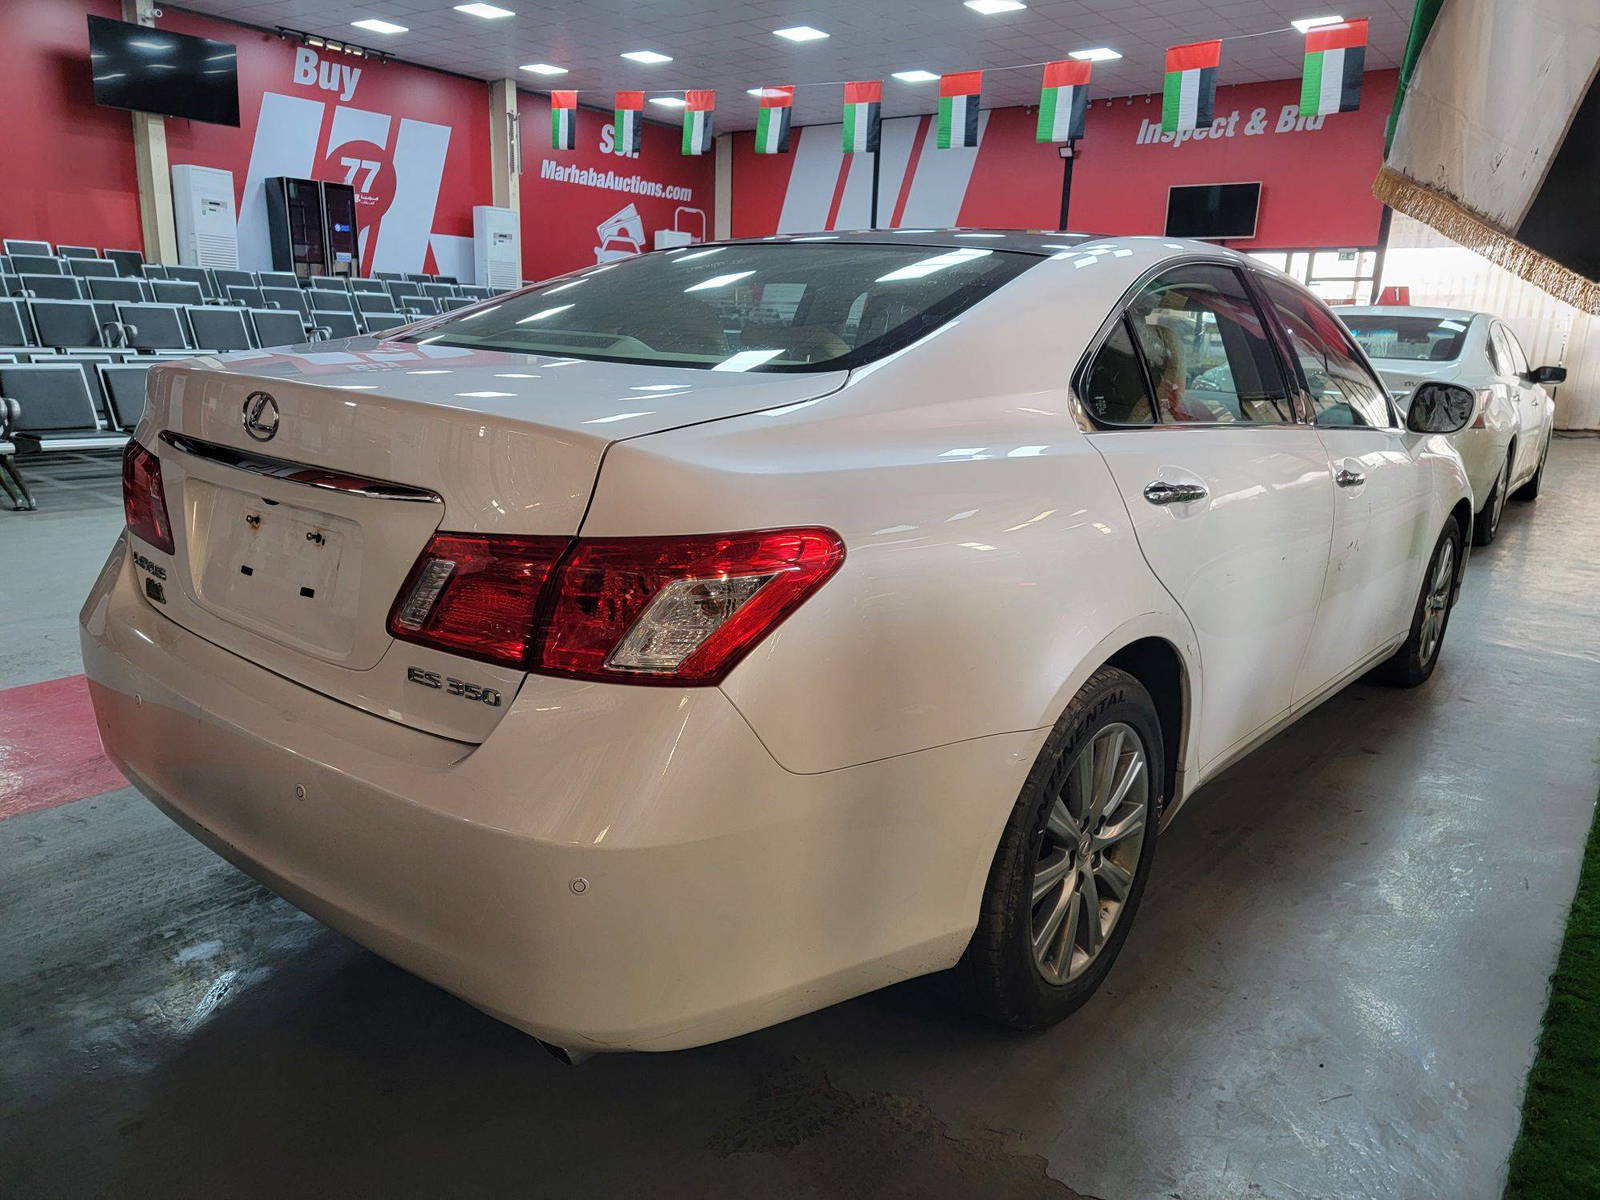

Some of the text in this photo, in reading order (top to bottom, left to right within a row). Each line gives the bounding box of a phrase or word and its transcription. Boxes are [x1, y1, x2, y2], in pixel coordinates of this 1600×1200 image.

[294, 47, 361, 101] Buy
[1244, 107, 1268, 136] &
[340, 157, 381, 193] 77
[542, 159, 692, 202] MarhabaAuctions.com
[408, 666, 501, 706] ES 350
